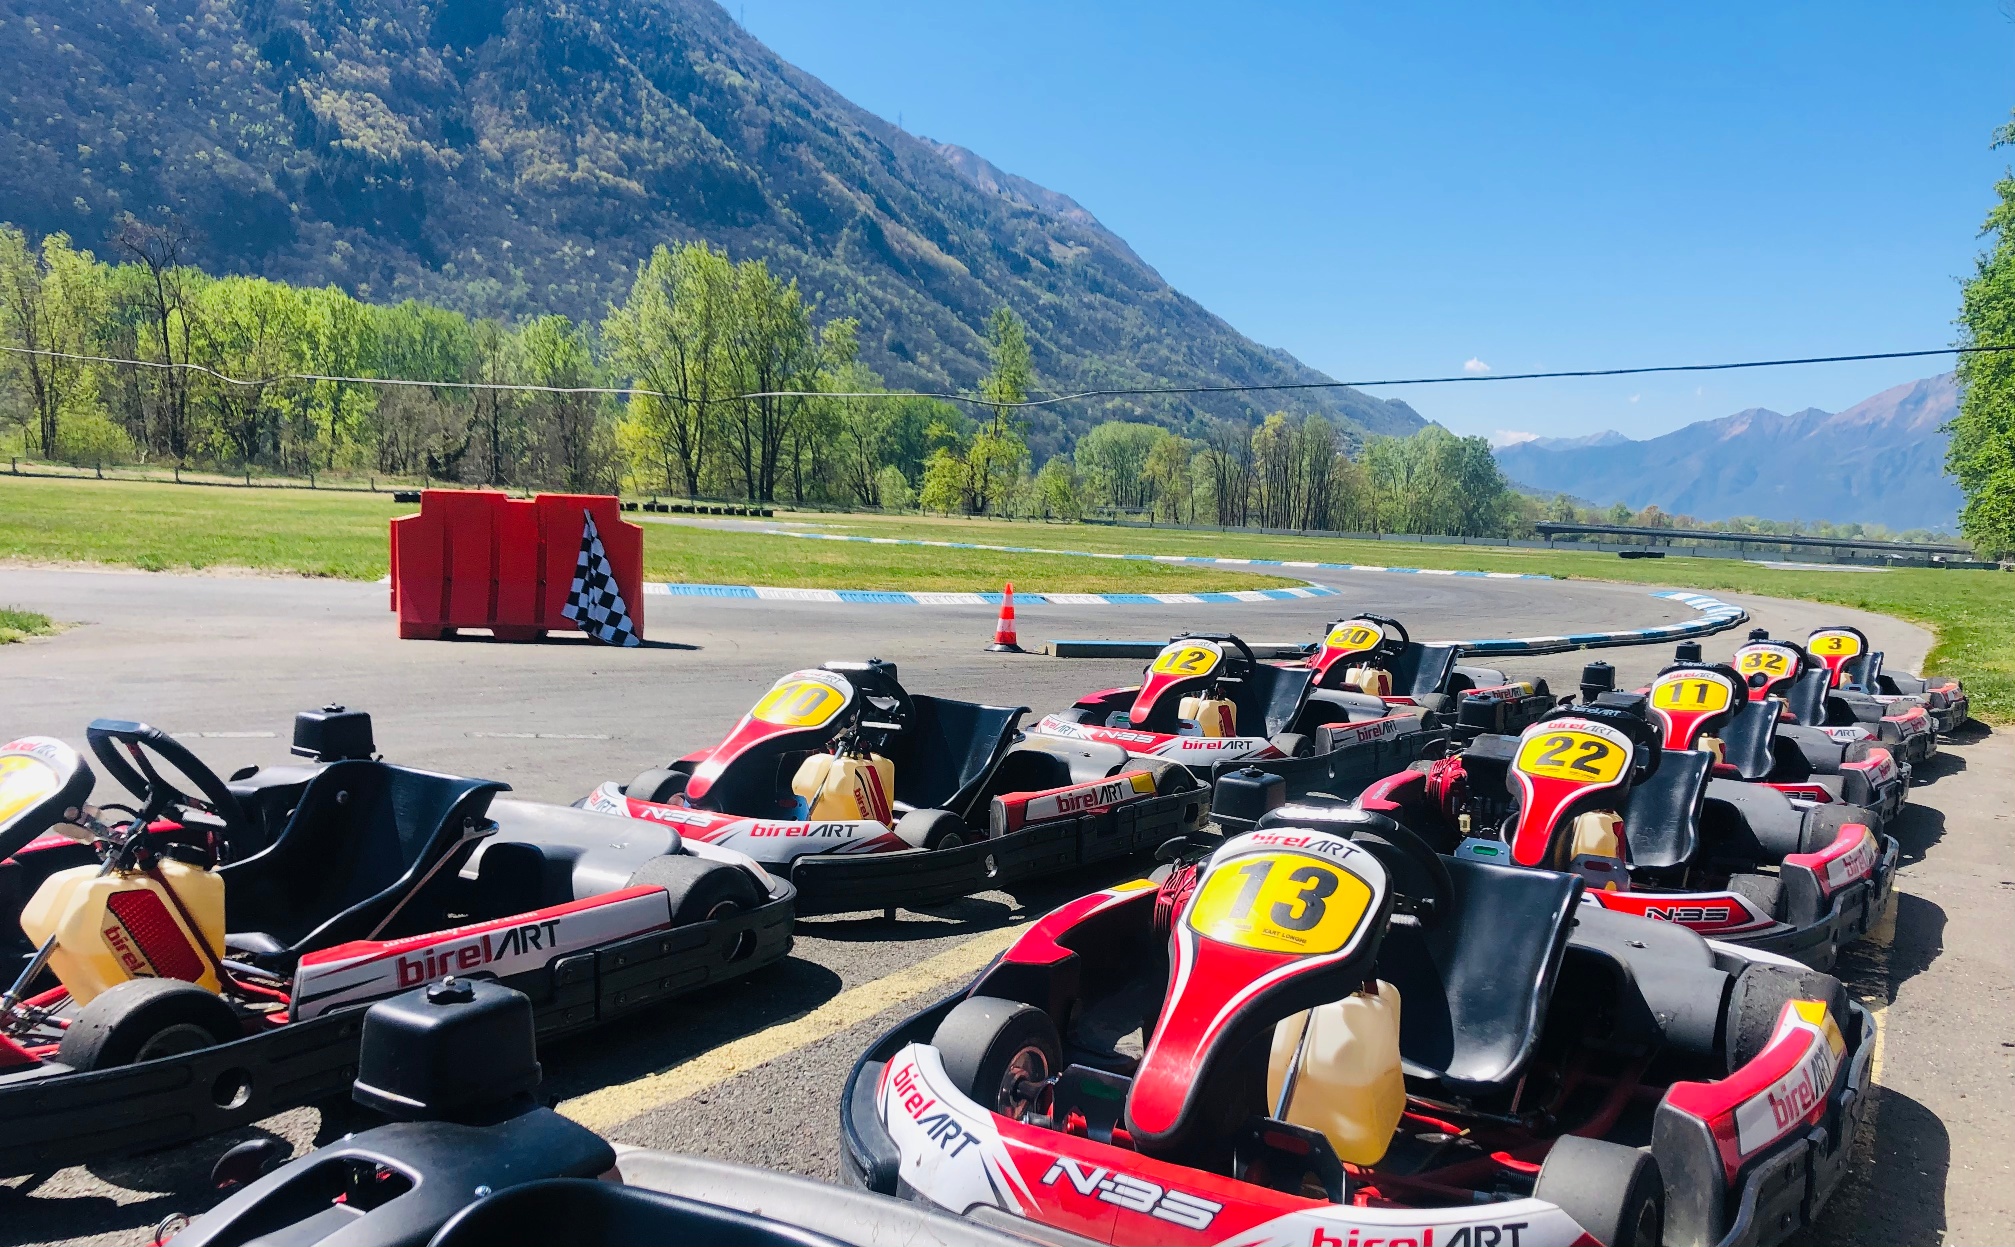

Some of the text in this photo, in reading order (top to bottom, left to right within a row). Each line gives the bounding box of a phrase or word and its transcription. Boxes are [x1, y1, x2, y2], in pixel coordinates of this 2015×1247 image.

[1335, 629, 1370, 644] 30
[1828, 637, 1842, 650] 3
[1165, 650, 1206, 671] 12
[1745, 653, 1783, 670] 32
[771, 684, 829, 716] 10
[1669, 682, 1709, 704] 11
[1182, 740, 1253, 750] birelART
[1356, 719, 1397, 742] birelART
[1535, 736, 1609, 775] 22
[853, 787, 869, 819] birel
[1056, 782, 1124, 813] birelART
[750, 823, 859, 838] birelART
[1251, 833, 1361, 860] birelART
[1228, 860, 1339, 931] 13
[1646, 907, 1730, 922] N-35
[103, 925, 150, 976] birel
[398, 919, 561, 988] birelART
[1767, 1042, 1834, 1130] birelART
[893, 1063, 981, 1158] birelART
[1040, 1156, 1226, 1232] N-35
